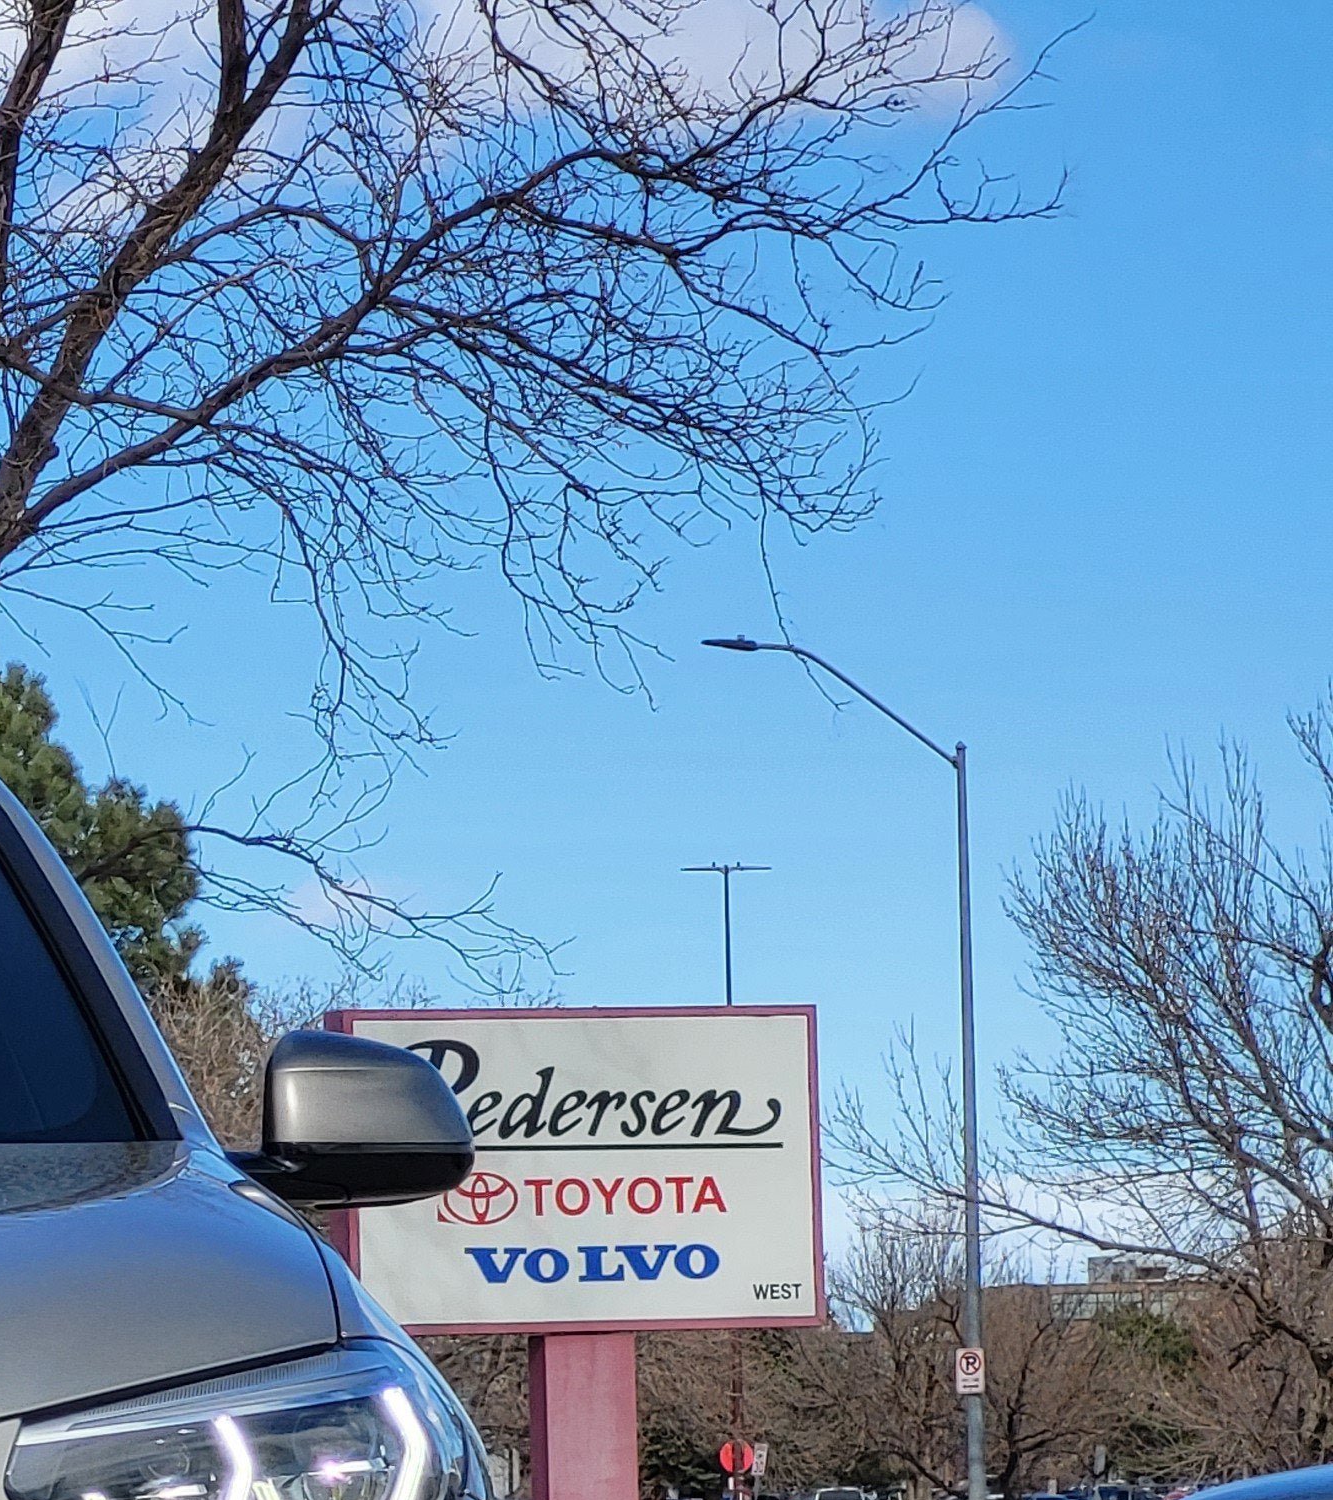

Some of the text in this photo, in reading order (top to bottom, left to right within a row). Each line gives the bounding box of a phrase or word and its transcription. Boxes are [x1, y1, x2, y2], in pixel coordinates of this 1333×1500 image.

[405, 1038, 782, 1140] Pedersen
[523, 1175, 728, 1217] TOYOTA
[464, 1243, 720, 1284] VOLVO
[752, 1282, 803, 1301] WEST
